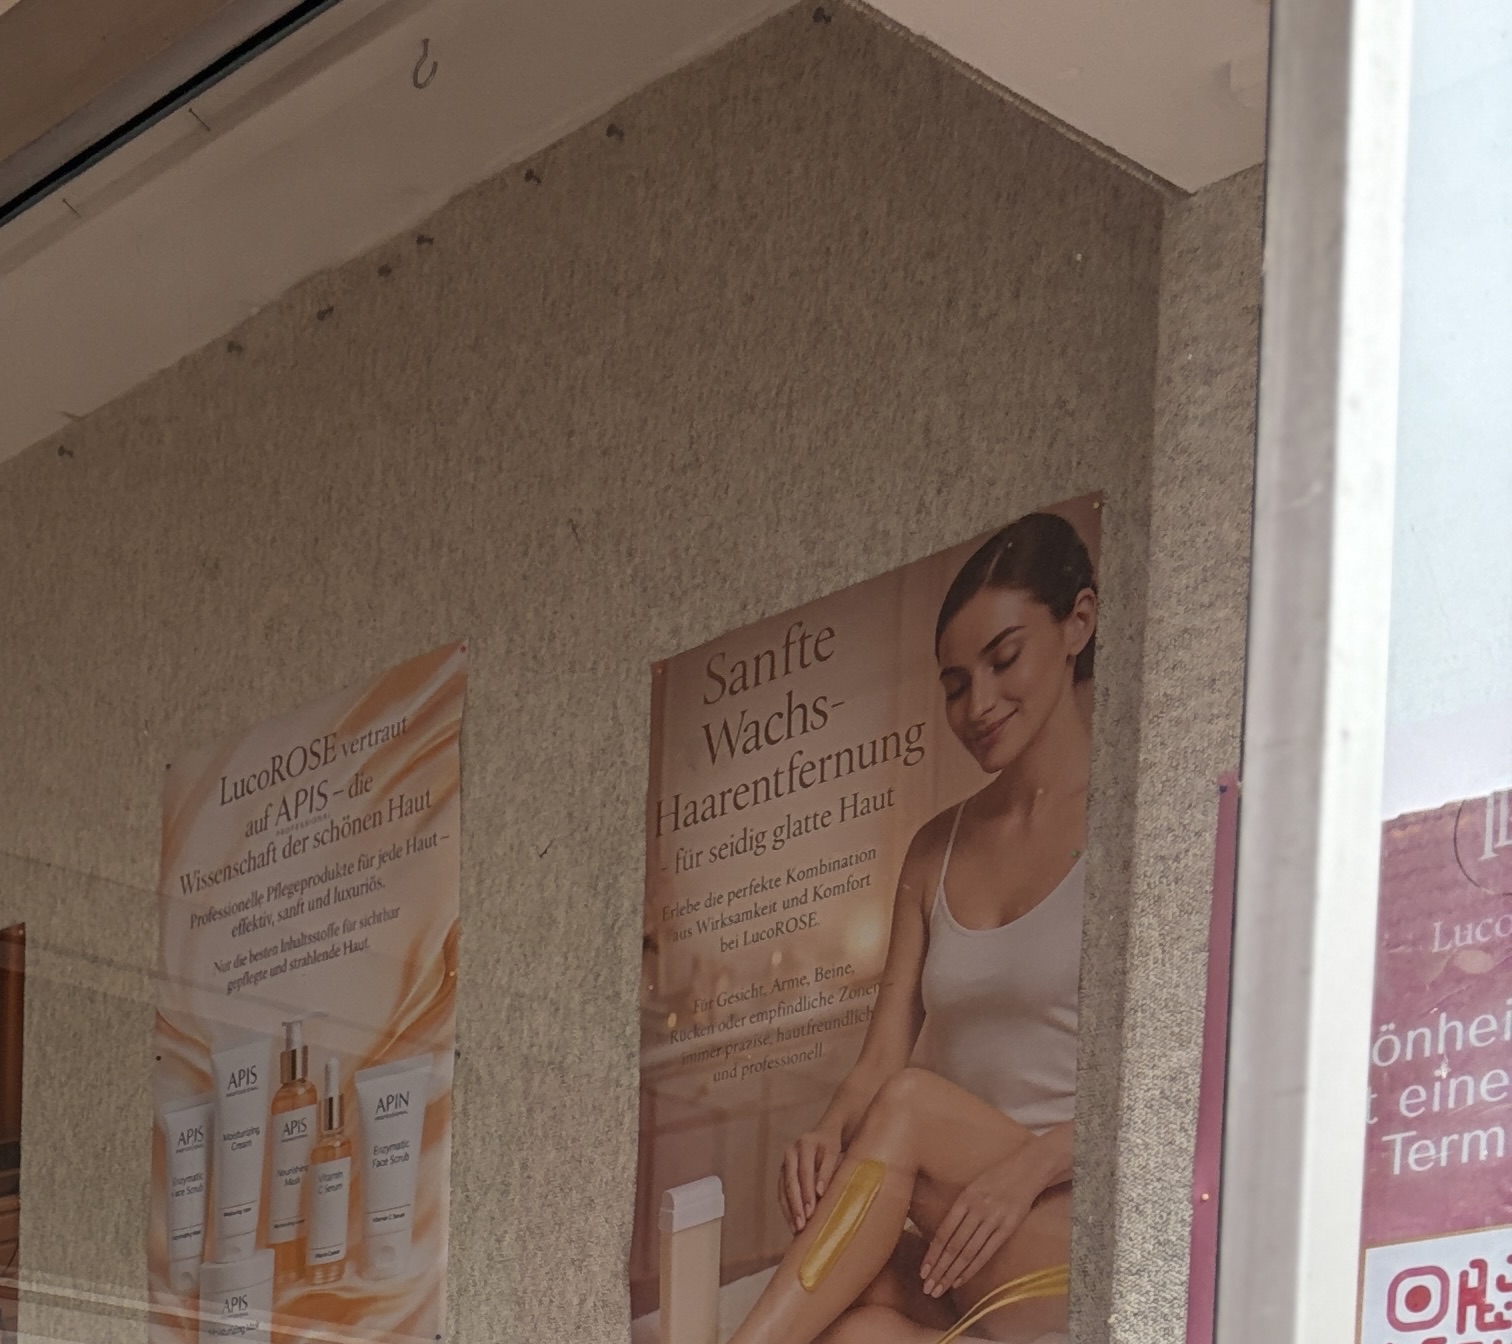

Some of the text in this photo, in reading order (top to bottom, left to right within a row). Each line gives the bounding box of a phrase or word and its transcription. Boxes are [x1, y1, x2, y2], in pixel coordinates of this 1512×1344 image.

[703, 620, 836, 705] Sanfte
[219, 716, 409, 806] LucoROSE vertraut
[702, 690, 845, 767] Wachs-
[244, 772, 374, 838] auf APIS die
[655, 722, 926, 839] Haarentfernung
[179, 788, 433, 897] Wissenschaft der schönen Haut
[675, 787, 895, 874] für seidig glatte Haut
[189, 832, 437, 930] Professionelle Pflegeprodukte für jede Haut
[231, 877, 385, 938] effektiv, sanft und luxuriös.
[662, 847, 877, 922] Erlebe die perfekte Kombination
[672, 873, 871, 943] aus Wirksamkeit und Komfort
[720, 911, 820, 953] bei LucoROSE.
[227, 1065, 258, 1091] APIS
[1399, 1064, 1509, 1119] eine
[283, 1117, 307, 1136] APIS
[1381, 1125, 1505, 1175] Term
